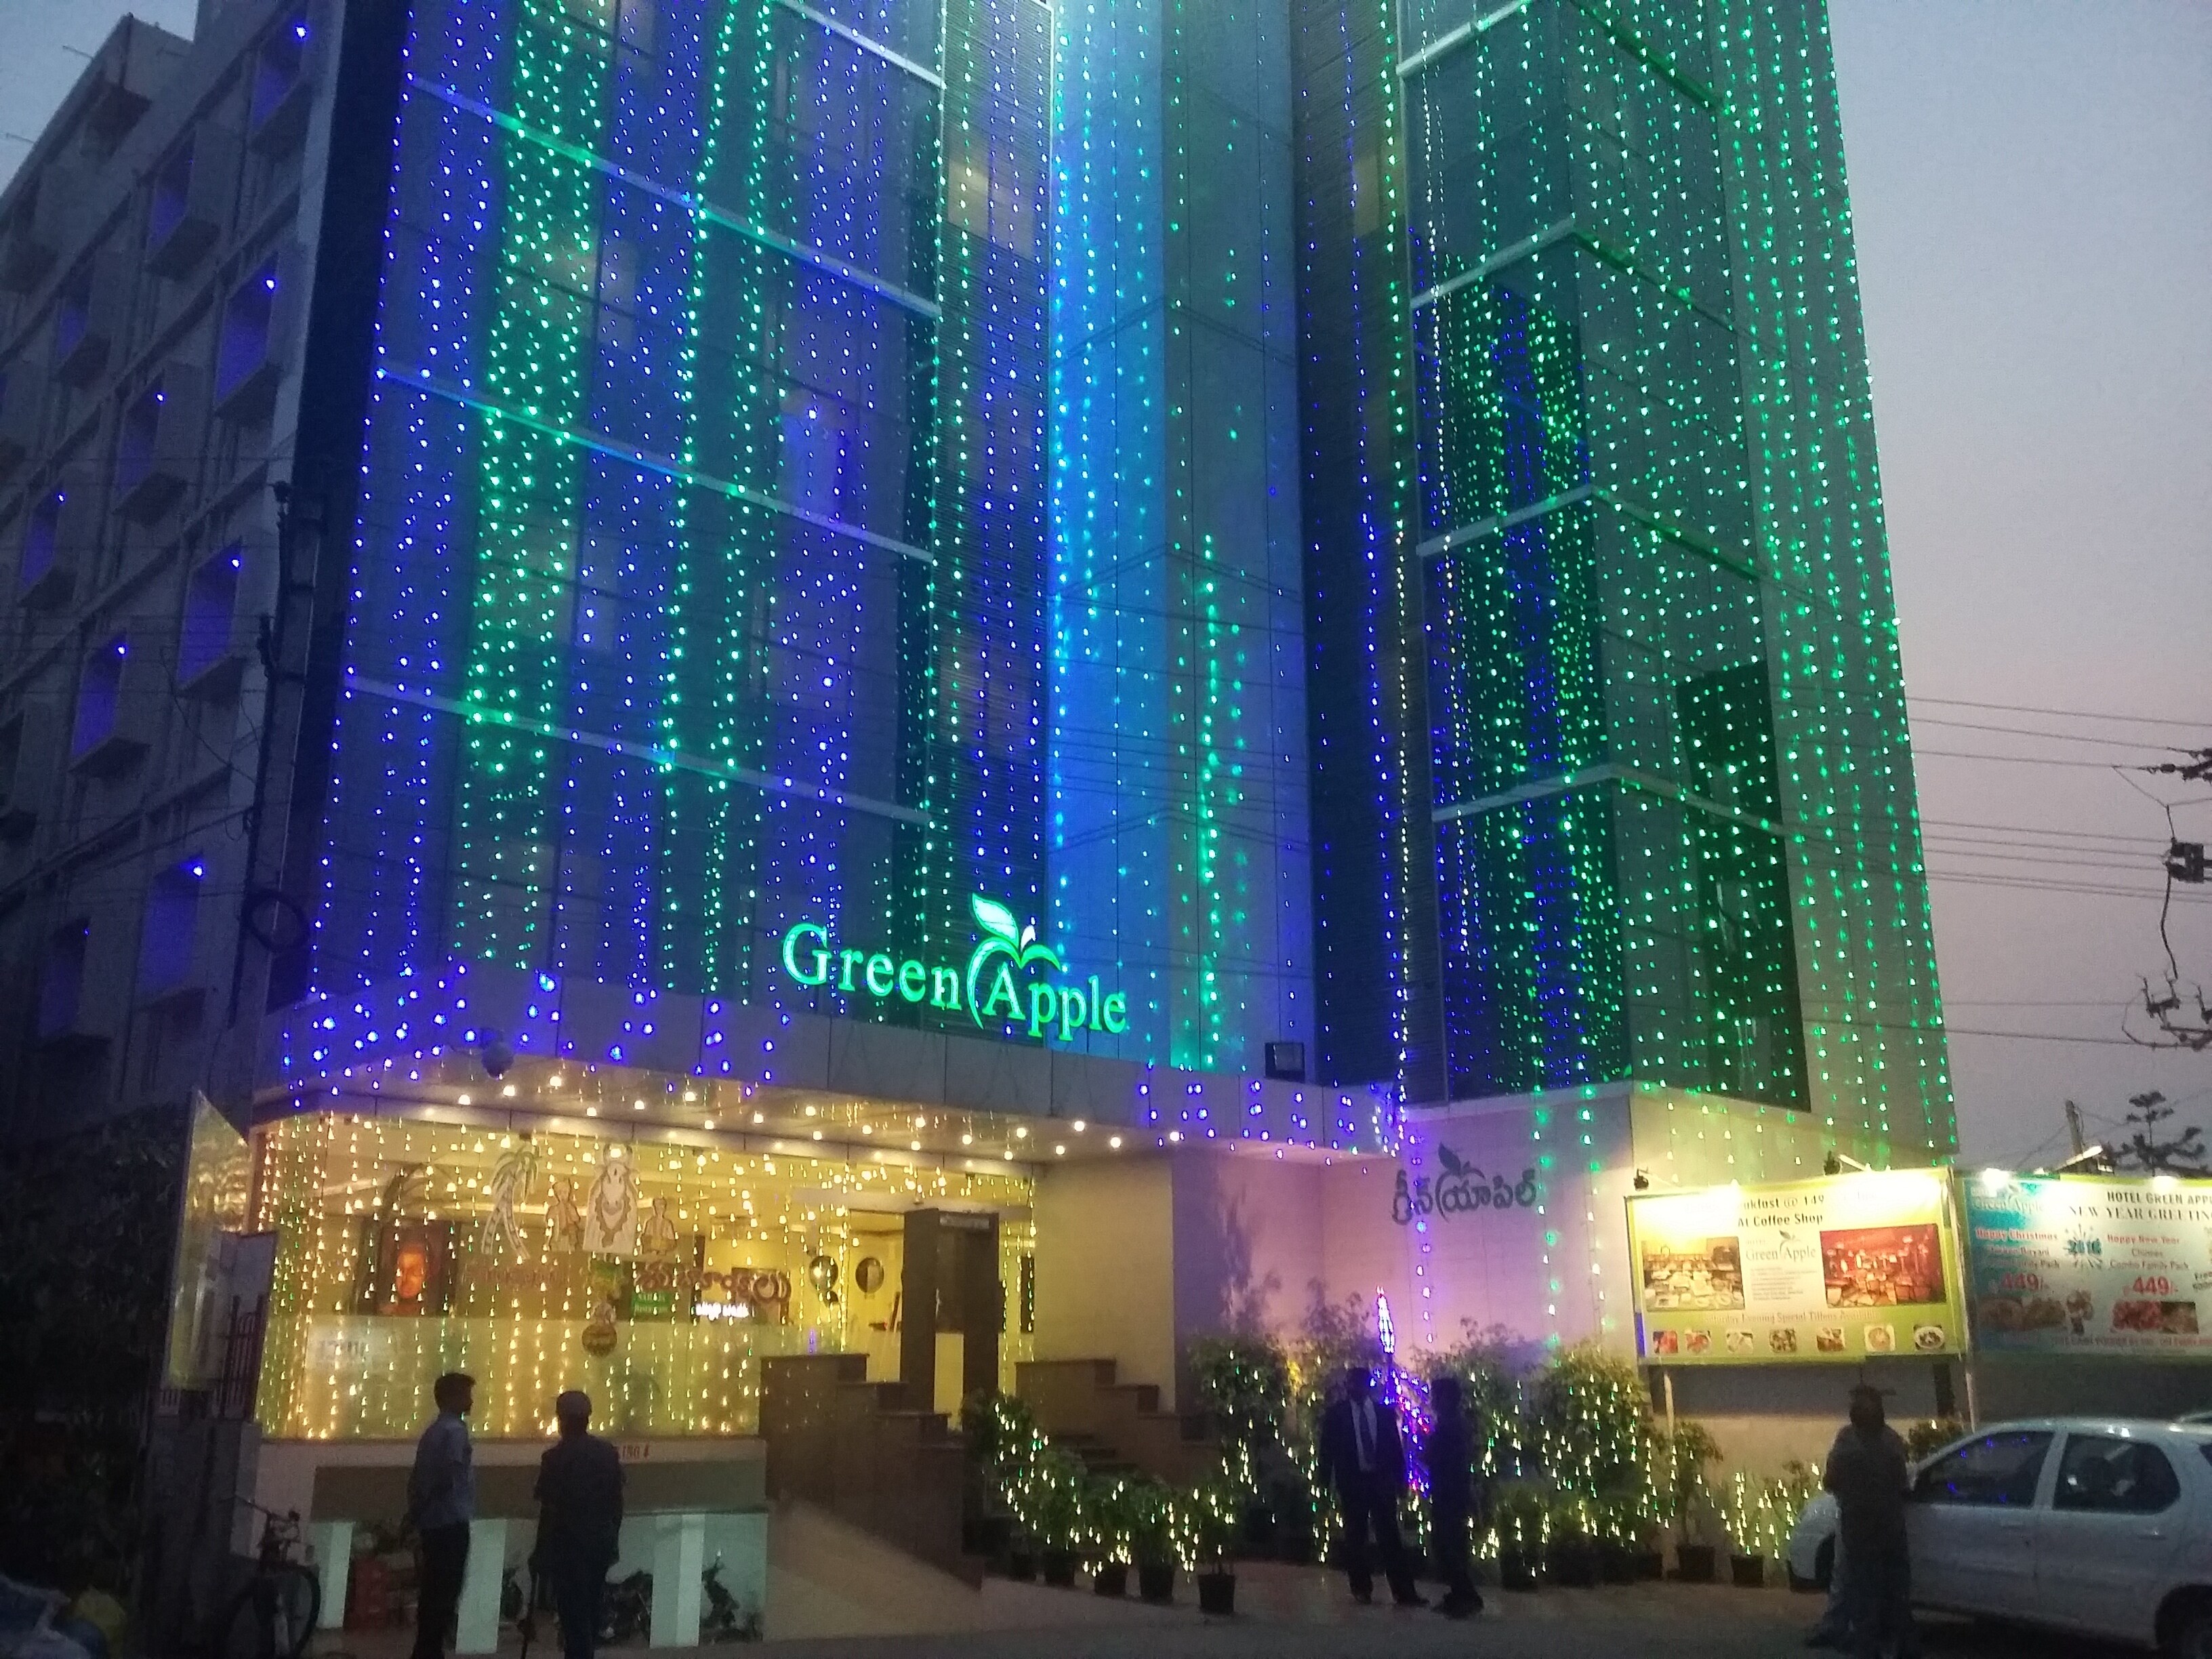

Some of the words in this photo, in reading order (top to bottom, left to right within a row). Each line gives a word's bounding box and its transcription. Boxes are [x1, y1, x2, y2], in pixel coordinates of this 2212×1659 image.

[783, 922, 962, 1010] Green
[981, 961, 1127, 1042] Apple
[2107, 1191, 2141, 1204] HOTEL
[2146, 1191, 2183, 1204] GREEN
[1753, 1212, 1790, 1227] Coffee
[1794, 1211, 1824, 1226] Shop
[2106, 1206, 2144, 1220] YEAR
[1746, 1248, 1779, 1263] Green
[1783, 1245, 1817, 1263] Apple
